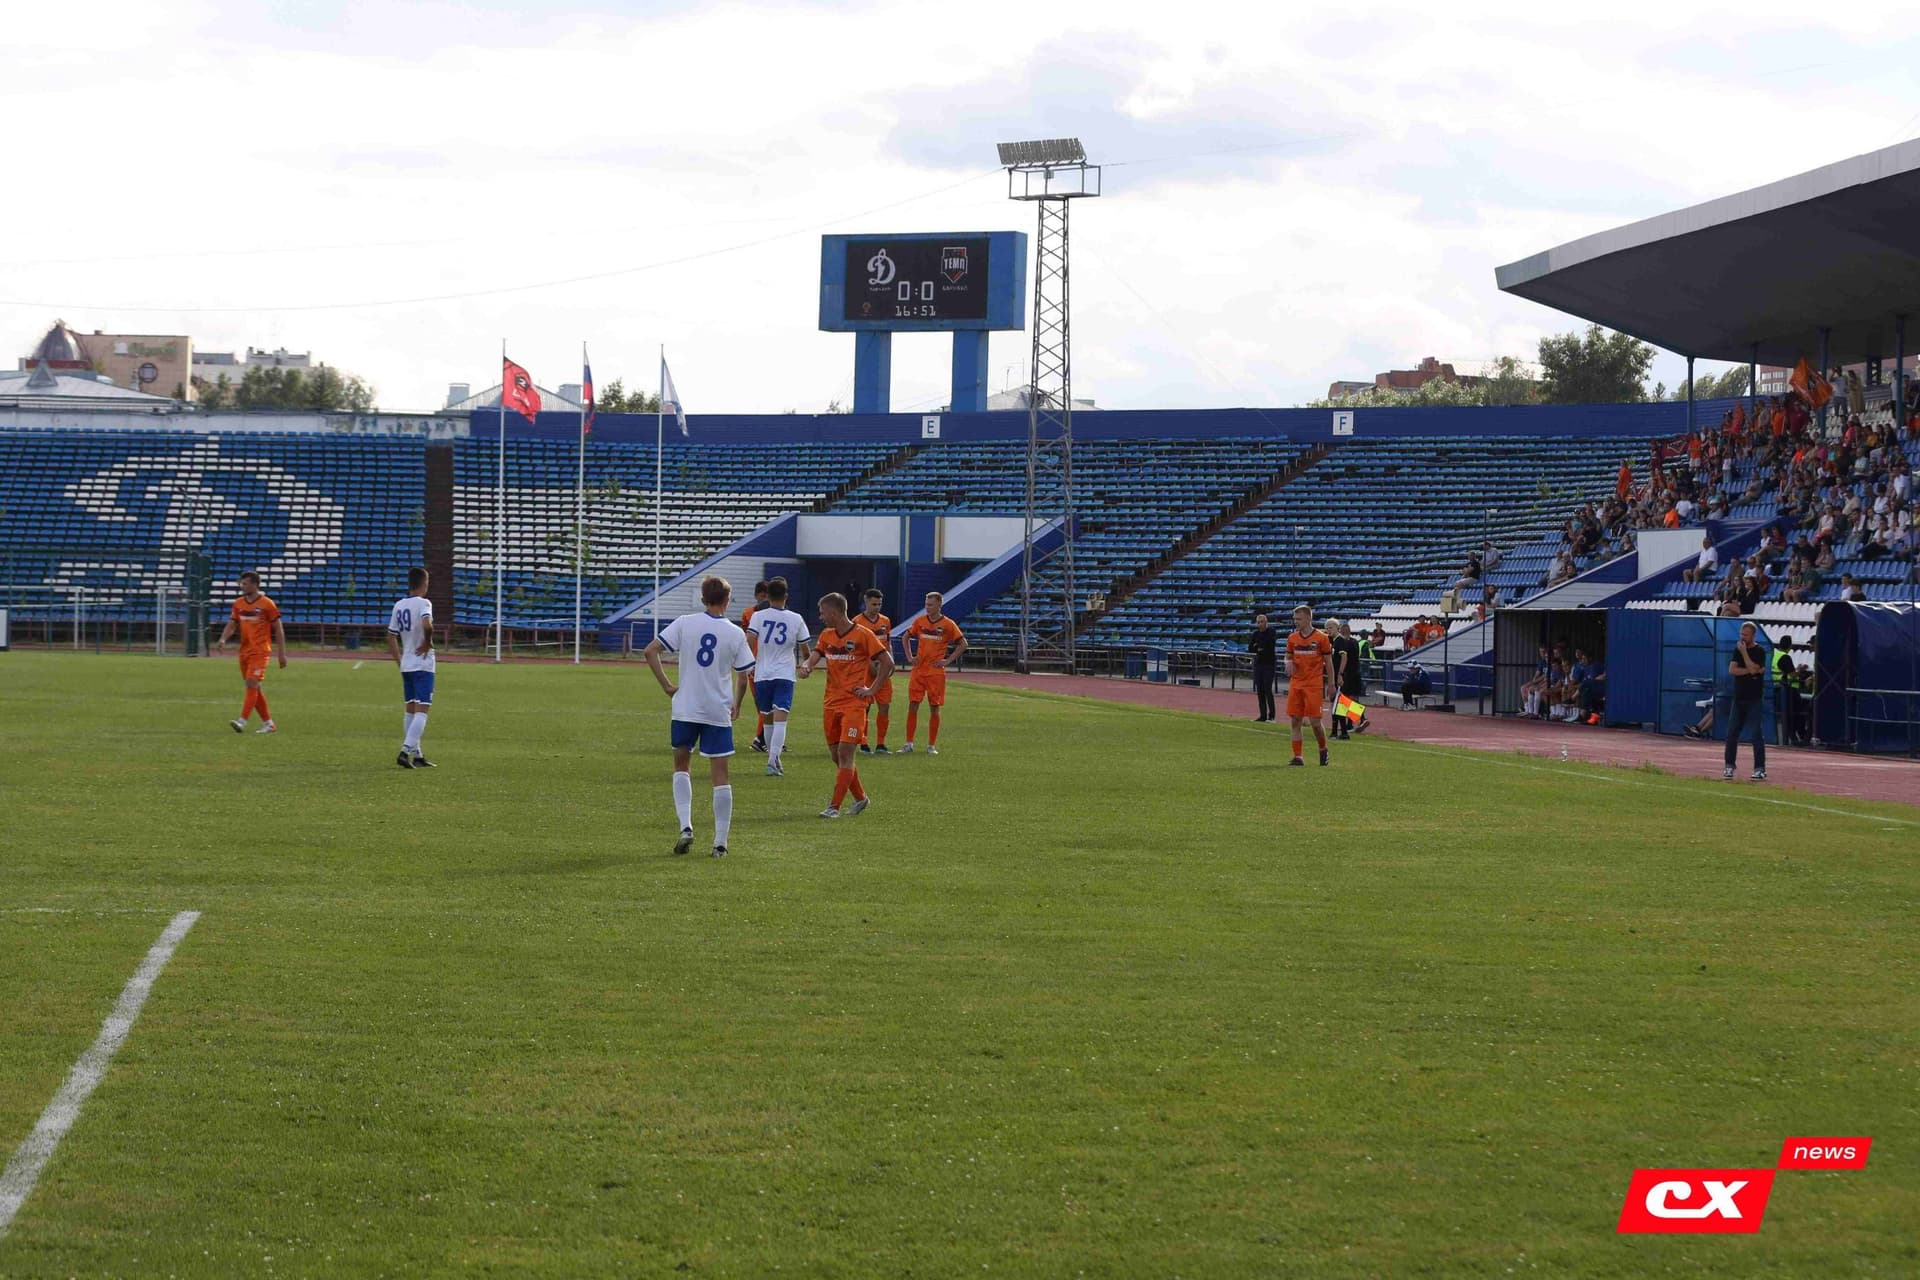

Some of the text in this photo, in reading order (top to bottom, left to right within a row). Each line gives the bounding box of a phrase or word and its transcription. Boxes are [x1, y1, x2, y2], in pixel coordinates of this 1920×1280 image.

[895, 305, 936, 317] 16:51
[927, 420, 935, 434] E
[1339, 416, 1347, 431] F
[396, 608, 412, 632] 89
[762, 620, 787, 645] 73
[696, 633, 717, 667] 8
